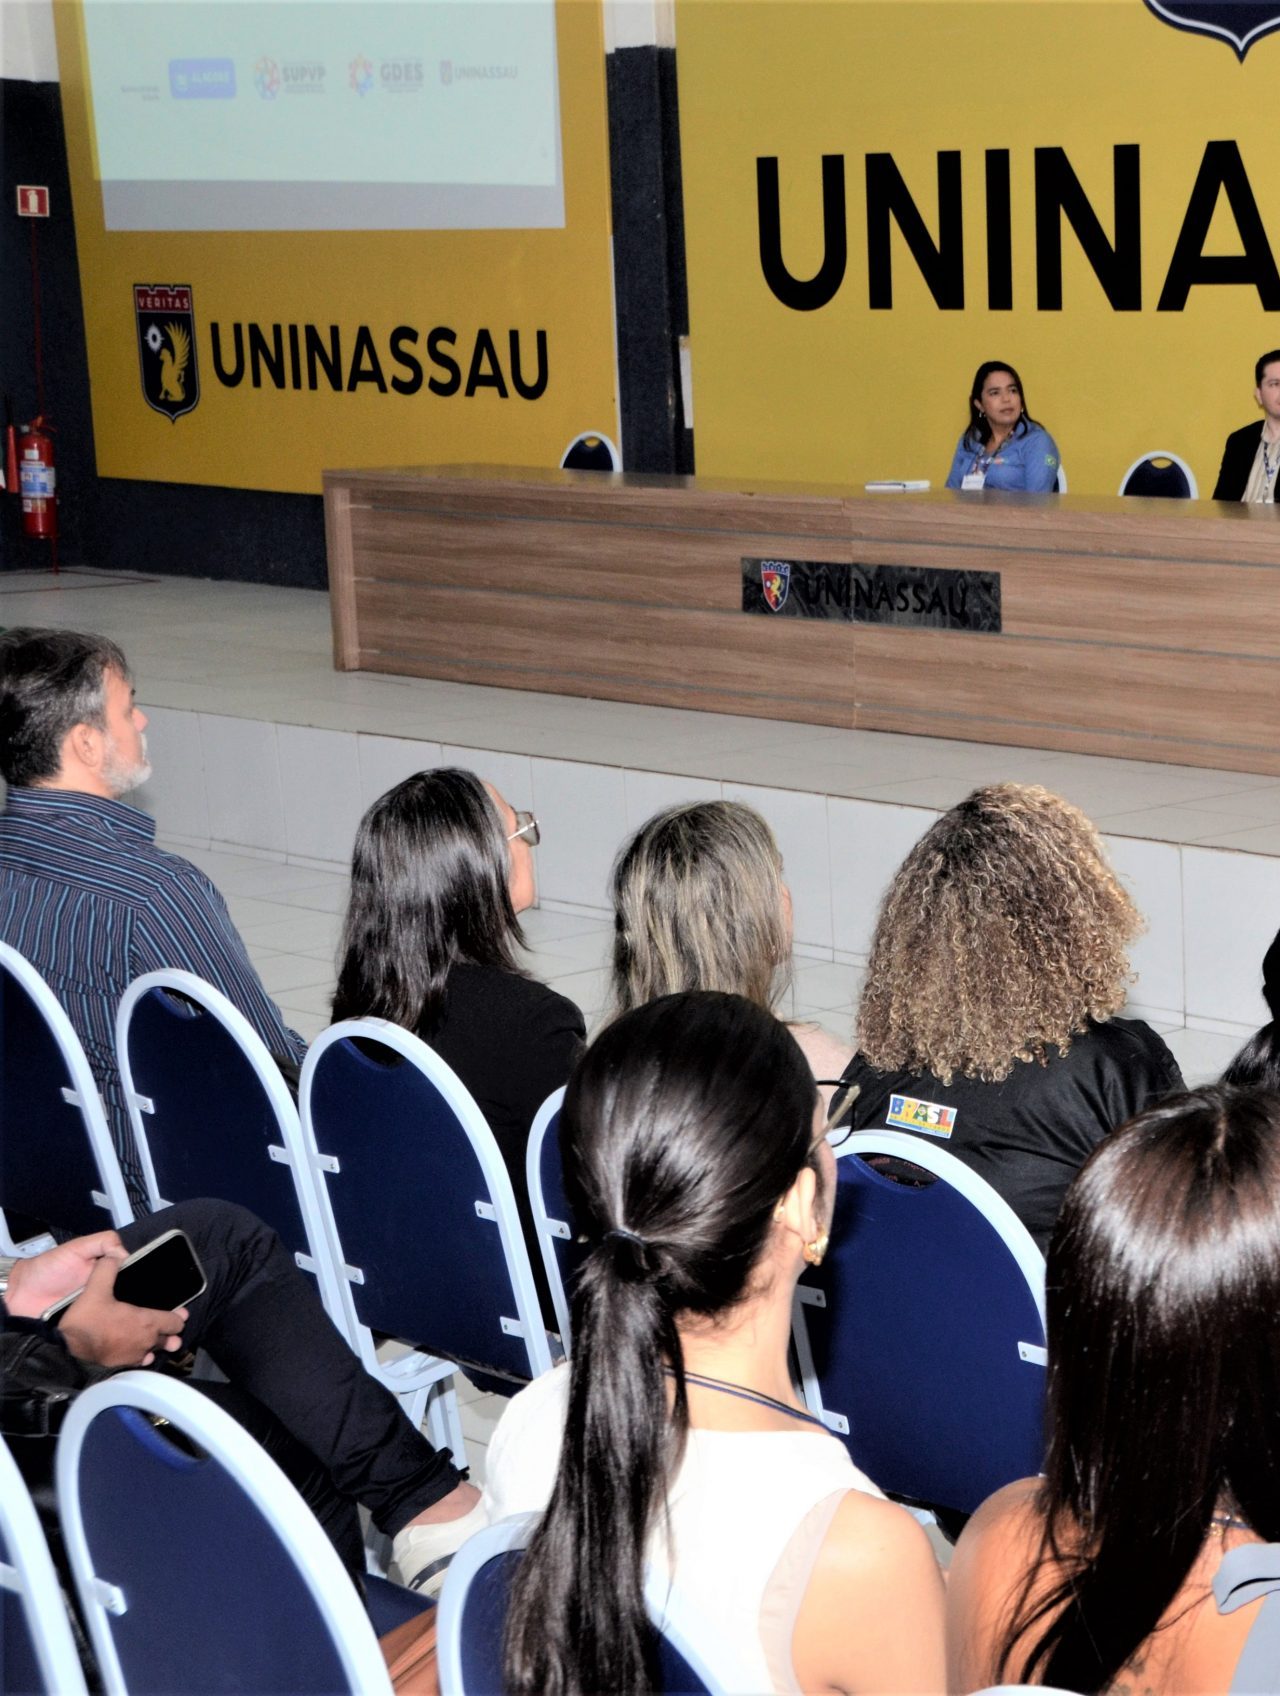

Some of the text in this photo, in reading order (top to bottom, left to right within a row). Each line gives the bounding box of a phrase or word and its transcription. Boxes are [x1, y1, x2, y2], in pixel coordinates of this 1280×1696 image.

[282, 65, 326, 83] SUPVP
[380, 63, 424, 81] GDES
[454, 64, 519, 80] UNINASSAU
[138, 297, 189, 309] VERITAS
[210, 322, 549, 401] UNINASSAU
[804, 573, 969, 621] UNINASSAU
